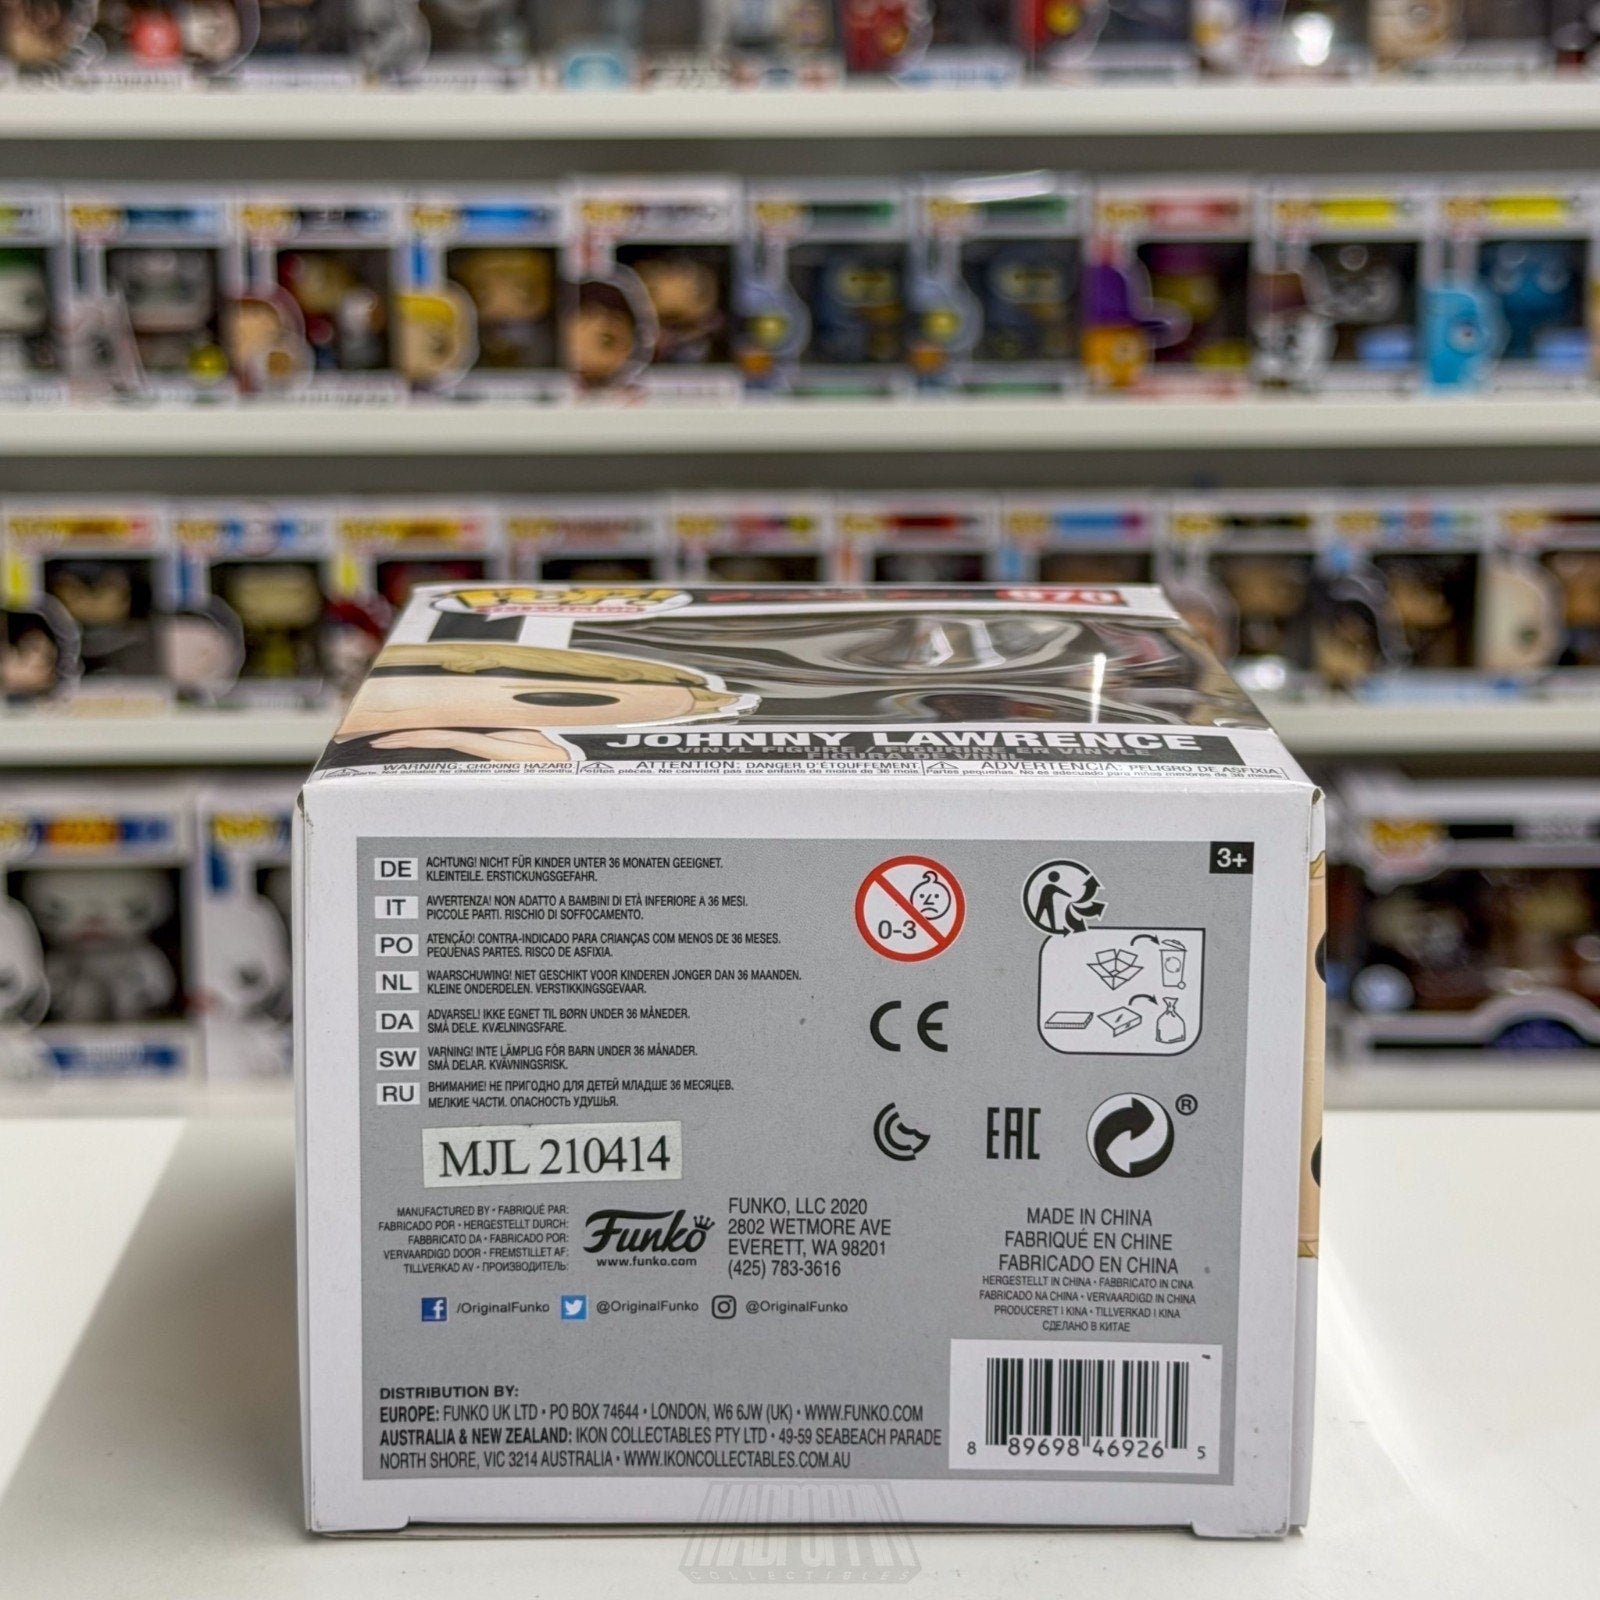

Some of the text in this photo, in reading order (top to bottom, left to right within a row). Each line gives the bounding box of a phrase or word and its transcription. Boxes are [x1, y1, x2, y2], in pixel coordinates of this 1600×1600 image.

[606, 731, 1203, 751] JOHNNY LAWRENCE
[676, 746, 754, 754] VINYL
[884, 746, 1005, 754] FIGURINE
[1014, 747, 1043, 755] EN
[1053, 748, 1151, 756] VINYLE
[956, 753, 1024, 761] VINIL
[636, 761, 739, 770] ATTENTION:
[746, 762, 802, 770] DANGER
[981, 761, 1123, 770] ADVERTENCIA:
[1129, 764, 1191, 772] PELIGRO
[425, 855, 723, 868] ACHTUNG! NICHT FÜR KINDER UNTER 36 MONATEN GEEIGNET.
[1216, 847, 1247, 868] 3+
[381, 860, 412, 877] DE
[425, 870, 597, 882] KLEINTEILE. ERSTICKUNGSGEFAHR.
[386, 899, 406, 916] IT
[424, 894, 748, 906] AVVERTENZA! NON ADATTO A BAMBINI DI ETÀ INFERIORE A 36 MESI.
[877, 920, 917, 940] 0-3
[380, 937, 413, 954] PO
[382, 974, 412, 991] NL
[426, 968, 801, 981] WAARSCHUWING! NIET GESCHIKT VOOR KINDEREN JONGER DAN 36 MAANDEN.
[381, 1013, 414, 1029] DA
[870, 1000, 949, 1052] CE
[379, 1050, 417, 1067] SW
[382, 1085, 415, 1102] RU
[427, 1079, 734, 1092] ВНИМАНИЕ! НЕ ПРИГОДНО ДЛЯ ДЕТЕЙ МЛАДШЕ 36 МЕСЯЦЕВ.
[438, 1135, 671, 1178] MJL 210414
[396, 1204, 569, 1217] MANUFACTURED BY FABRIQUÉ PAR:
[728, 1197, 868, 1215] FUNKO, LLC 2020
[1026, 1206, 1153, 1226] MADE IN CHINA
[583, 1209, 707, 1253] Funko
[727, 1218, 892, 1235] 2802 WETMORE AVE
[1004, 1228, 1173, 1250] FABRIQUÉ EN CHINE
[727, 1239, 885, 1257] EVERETT, WA 98201
[596, 1255, 697, 1267] www.funko.com
[727, 1260, 841, 1278] (425) 783-3616
[998, 1253, 1179, 1274] FABRICADO EN CHINA
[982, 1275, 1194, 1289] HERGESTELLT IN CHINA FABBRICATO IN CINA
[456, 1301, 550, 1316] /OriginalFunko
[595, 1300, 699, 1314] @OriginalFunko
[745, 1300, 848, 1314] @OriginalFunko
[1042, 1320, 1130, 1332] СДЕЛАНО В КИТАЕ
[378, 1384, 519, 1400] DISTRIBUTION BY:
[378, 1403, 923, 1424] EUROPE: FUNKO UK LTD PO BOX 74644 LONDON, W6 6JW (UK) WWW.FUNKO.COM
[378, 1427, 942, 1446] AUSTRALIA & NEW ZEALAND: IKON COLLECTABLES PTY LTD 49-59 SEABEACH PARADE
[966, 1437, 1206, 1459] 8 89698 46926 5
[378, 1450, 851, 1469] NORTH SHORE, VIC 3214 AUSTRALIA WWW.IKONCOLLECTABLES.COM.AU
